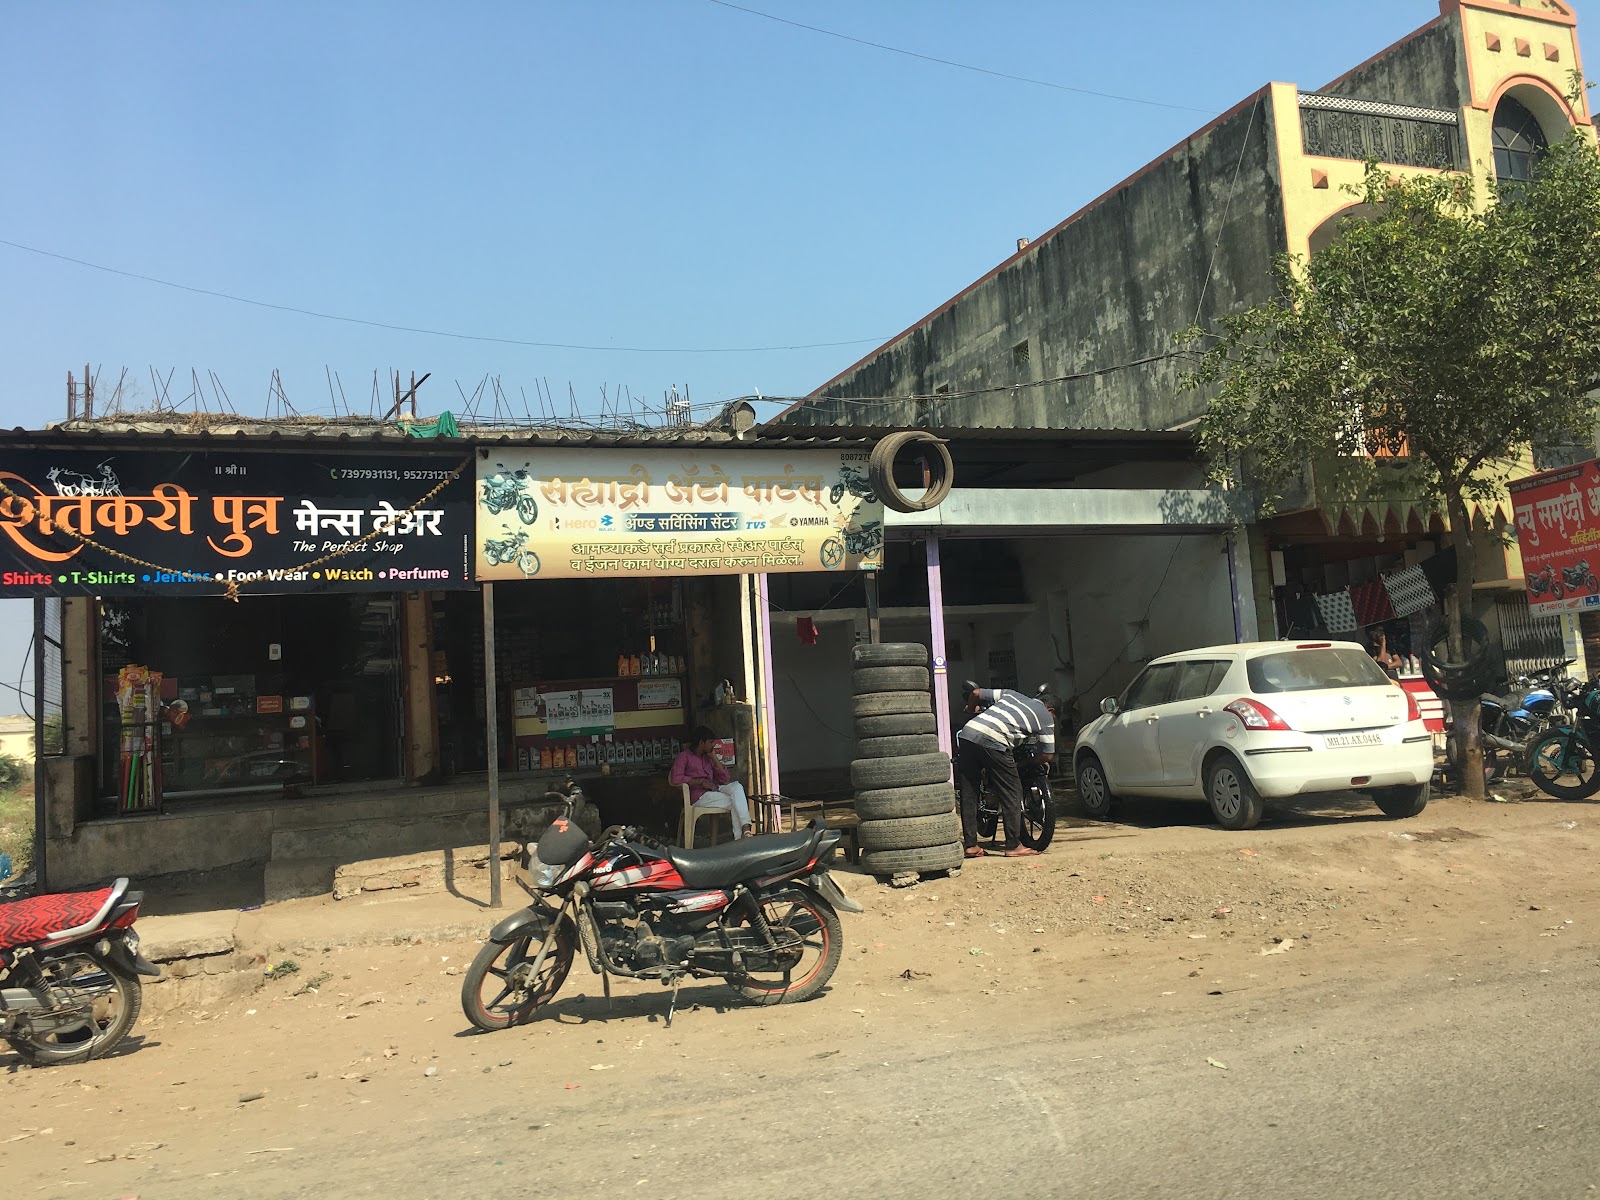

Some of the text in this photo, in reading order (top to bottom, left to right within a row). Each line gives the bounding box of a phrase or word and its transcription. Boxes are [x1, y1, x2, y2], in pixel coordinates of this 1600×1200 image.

[340, 470, 400, 480] 7397931131,
[539, 463, 652, 509] सह्याद्री
[741, 463, 827, 511] पार्टस्
[292, 500, 445, 536] मेन्स वेअर
[565, 518, 597, 529] Hero
[658, 513, 708, 531] सर्विसिंग
[710, 513, 738, 530] सेंटर
[746, 520, 766, 530] TVS
[799, 516, 830, 527] YAMAHA
[1516, 504, 1540, 546] न्यु
[206, 496, 284, 557] पुत्र
[292, 540, 404, 555] The Perfect Shop
[571, 536, 805, 555] आमच्याकडे सर्व प्रकारचे स्पेअर पार्टस्
[570, 558, 582, 570] व
[585, 555, 620, 573] इंजन
[622, 558, 652, 572] काम
[654, 556, 686, 571] योग्य
[688, 556, 722, 570] दरात
[761, 553, 804, 568] मिळेल.
[2, 571, 52, 585] Shirts
[70, 570, 136, 584] T-Shirts
[154, 570, 210, 584] Jerkins
[228, 568, 309, 582] Foot Wear
[325, 567, 374, 581] Watch
[389, 566, 450, 582] Perfume
[1546, 602, 1563, 612] Hero
[593, 866, 612, 874] Hero
